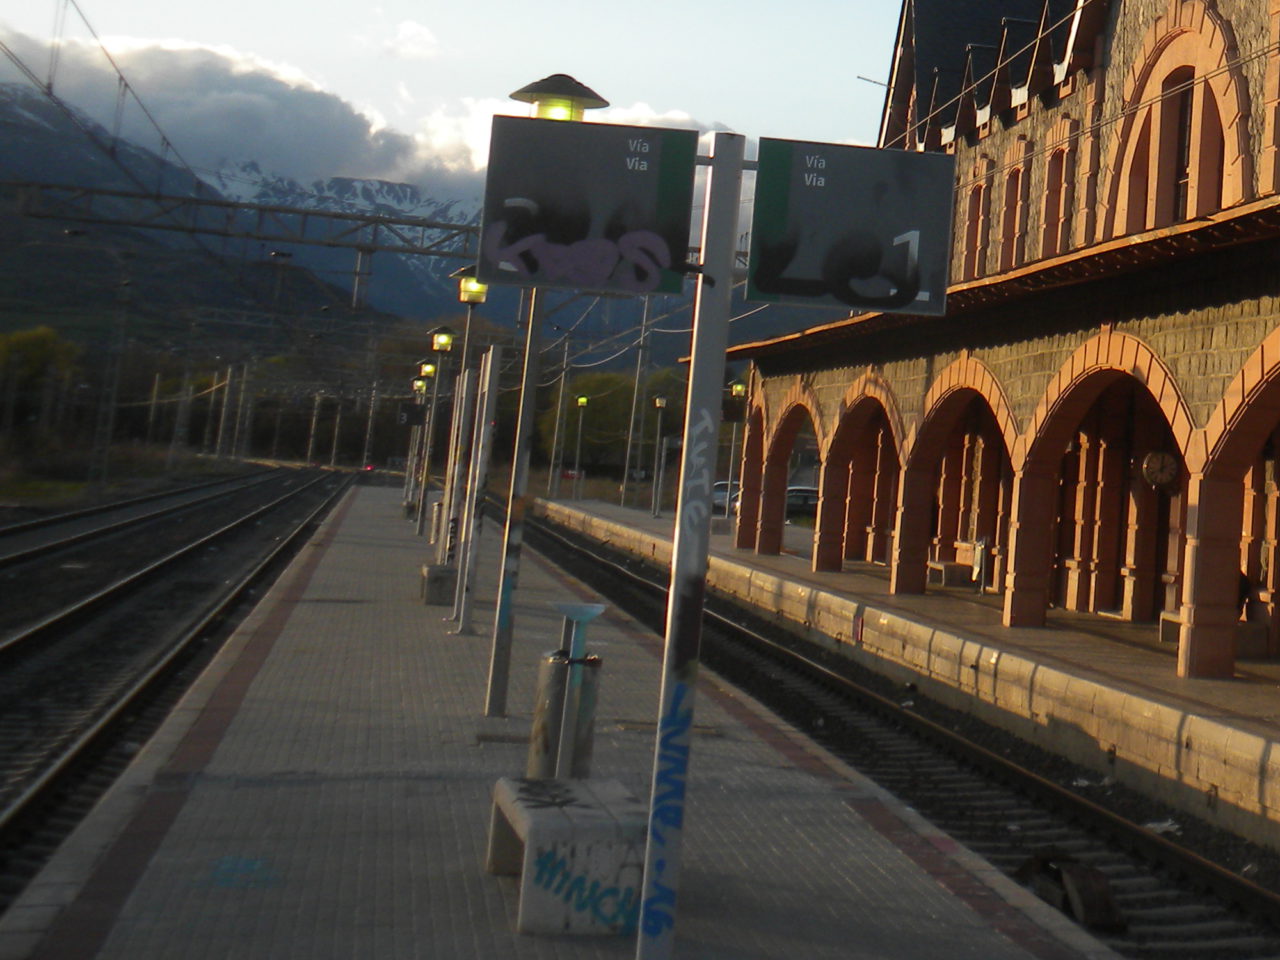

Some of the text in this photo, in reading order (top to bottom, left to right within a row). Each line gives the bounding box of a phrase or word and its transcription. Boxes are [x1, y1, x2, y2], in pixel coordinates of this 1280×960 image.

[629, 139, 649, 152] Vía
[626, 157, 648, 170] Via
[805, 155, 826, 169] Vía
[804, 173, 825, 187] Via
